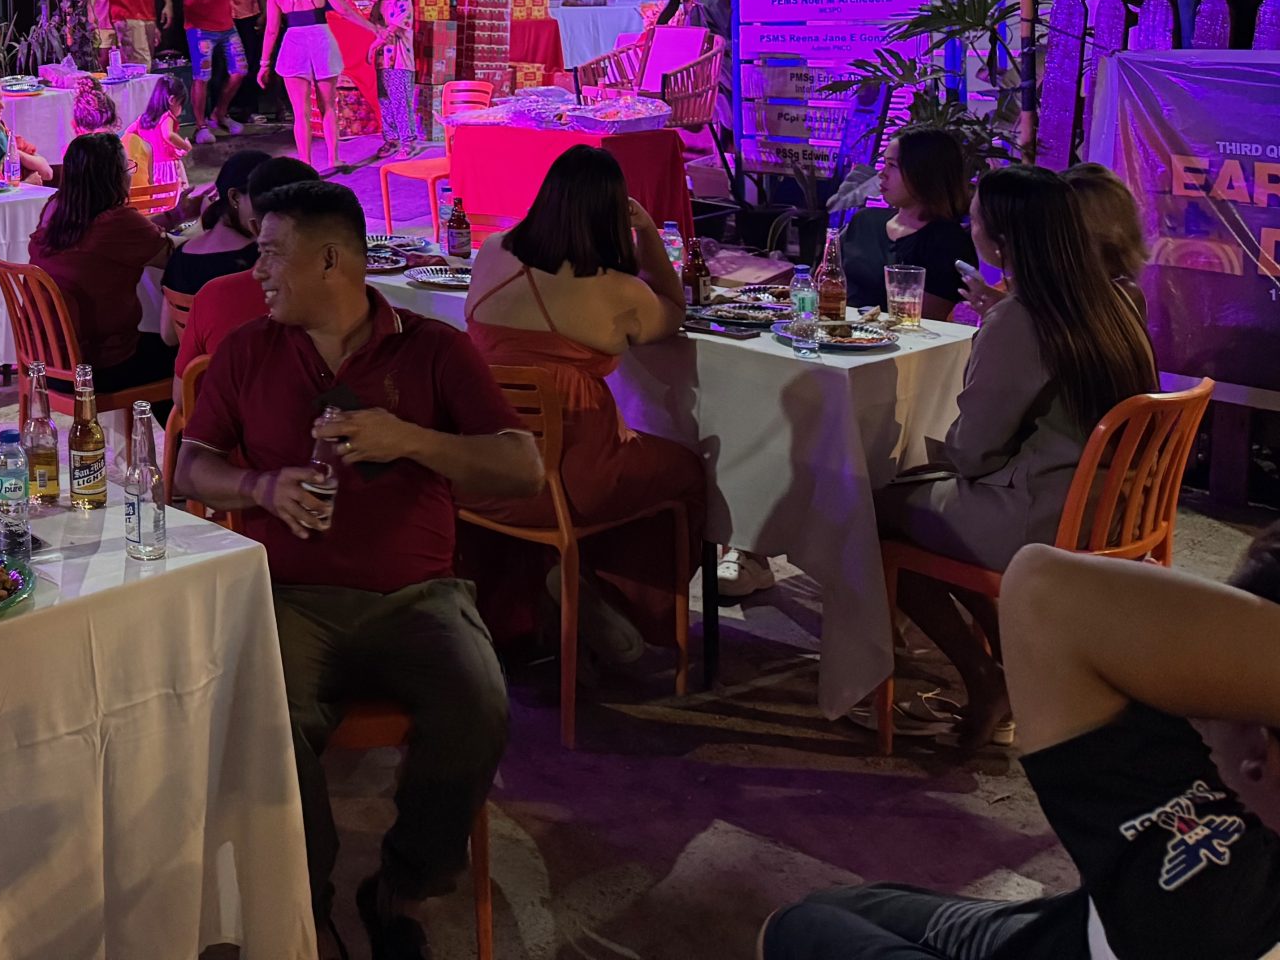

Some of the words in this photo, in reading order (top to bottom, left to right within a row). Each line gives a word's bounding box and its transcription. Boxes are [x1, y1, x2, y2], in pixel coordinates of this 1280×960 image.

[759, 34, 786, 43] PSMS
[822, 33, 847, 42] Jane
[789, 72, 815, 84] PMSg
[775, 148, 800, 162] PSSg
[802, 150, 830, 162] Edwin
[1216, 141, 1263, 157] THIRD
[73, 468, 90, 480] San
[76, 472, 104, 487] LIGHT
[4, 485, 23, 494] pure
